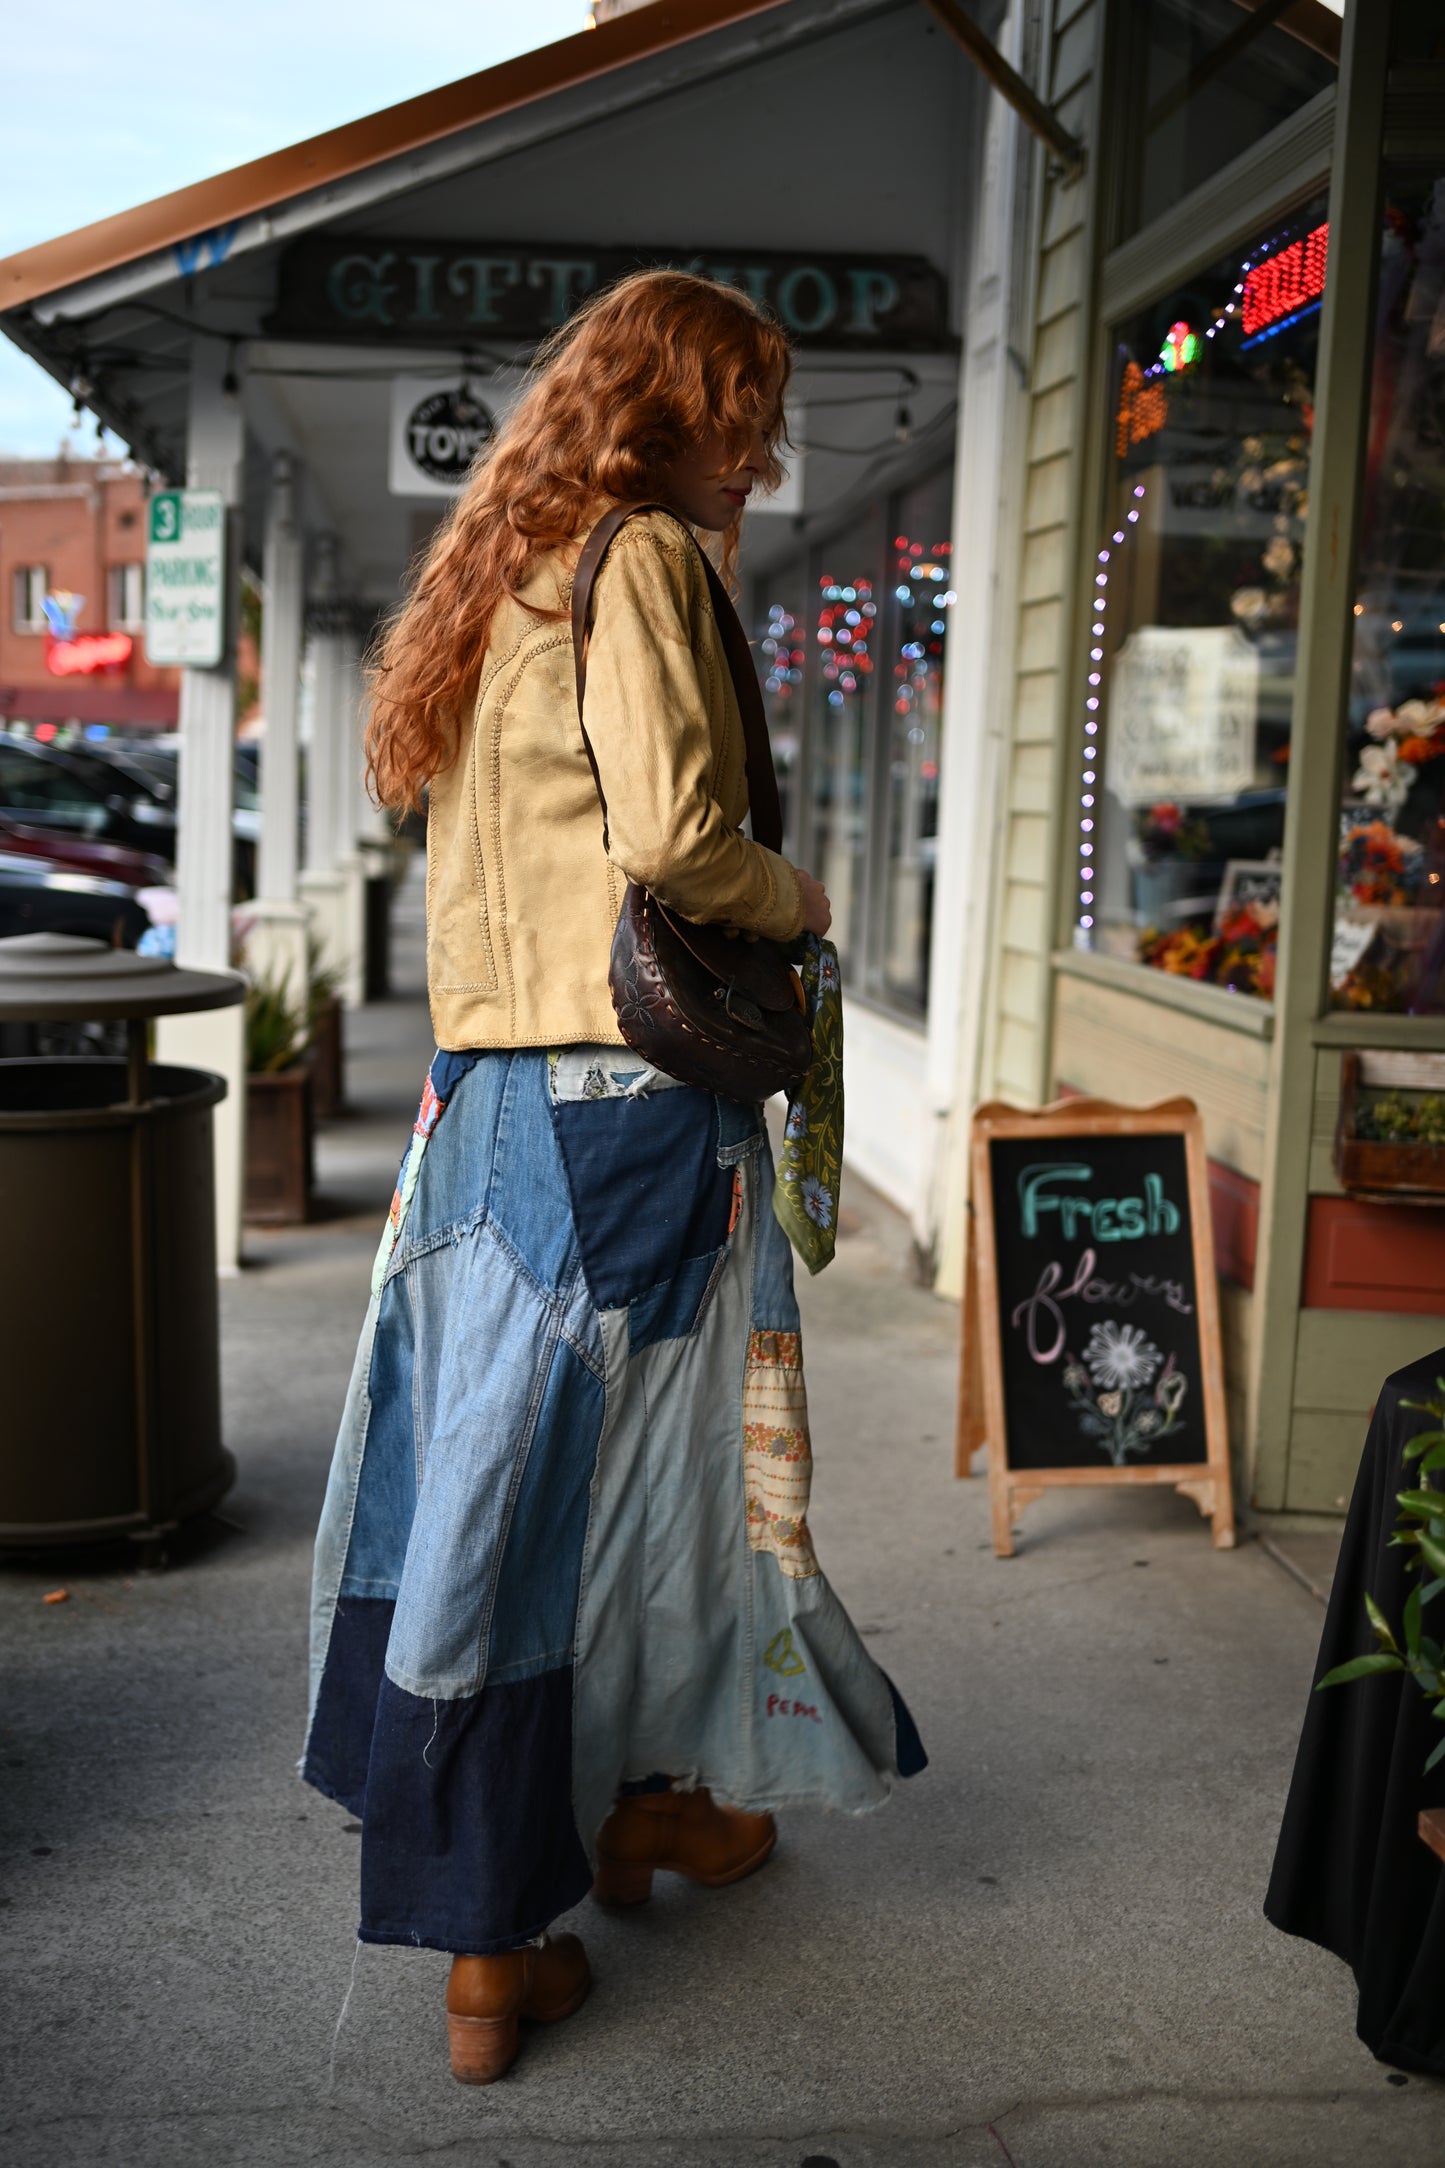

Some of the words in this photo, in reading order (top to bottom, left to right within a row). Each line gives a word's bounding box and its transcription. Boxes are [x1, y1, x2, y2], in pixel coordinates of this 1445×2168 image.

[326, 252, 596, 325] GIFT
[690, 258, 900, 334] HOP
[1017, 1161, 1181, 1241] Fresh
